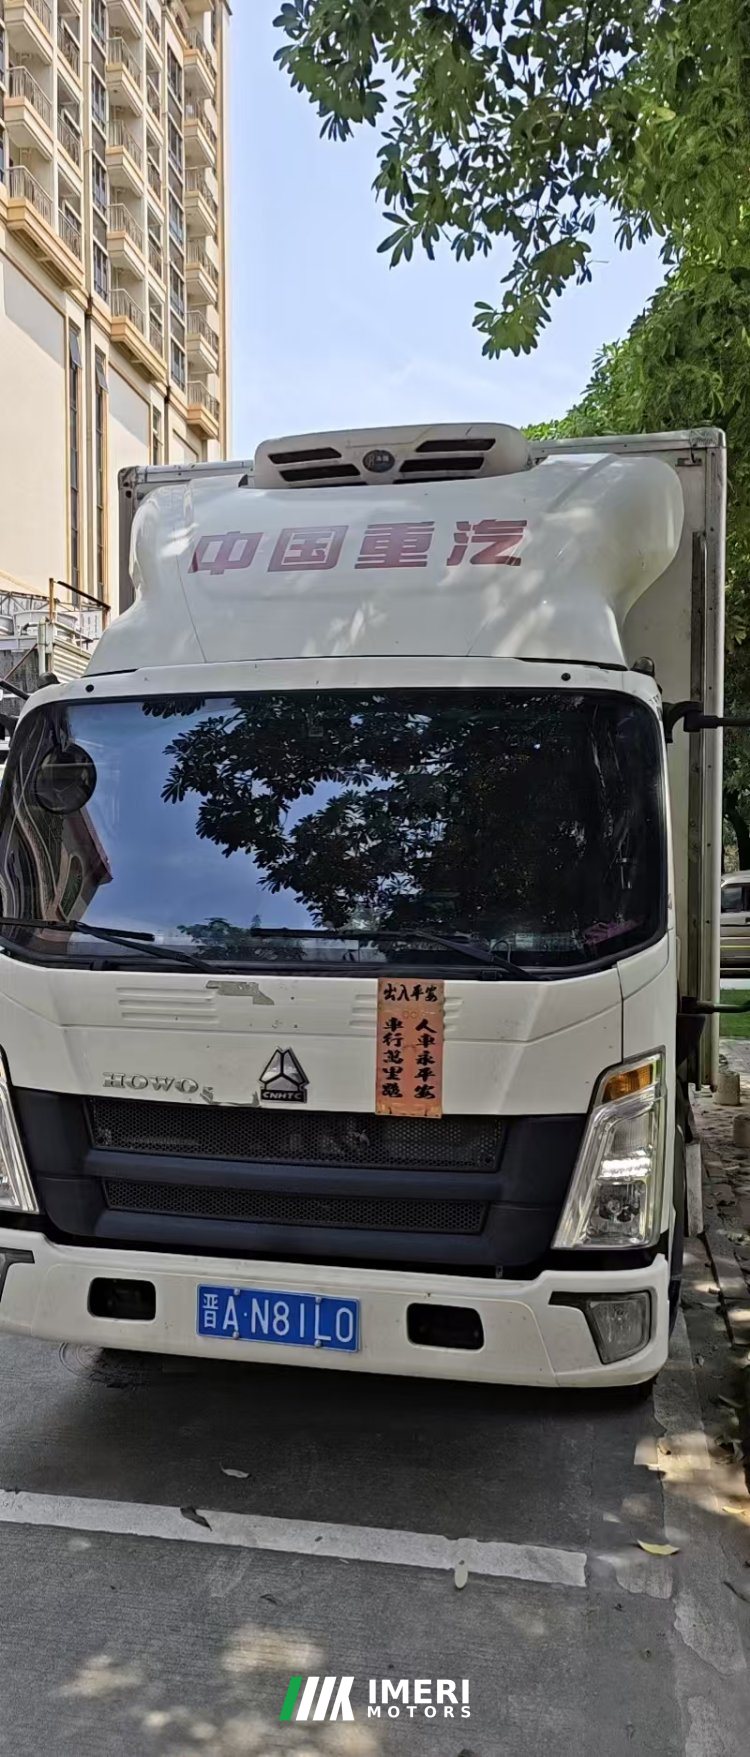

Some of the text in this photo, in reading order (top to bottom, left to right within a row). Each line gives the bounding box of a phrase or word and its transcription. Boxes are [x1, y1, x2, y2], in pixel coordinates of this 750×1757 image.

[188, 519, 527, 575] 中国重汽
[383, 983, 438, 1002] 出入平安
[414, 1018, 438, 1100] 人車永平安
[102, 1072, 199, 1094] HOWO
[262, 1091, 302, 1100] CNHTC
